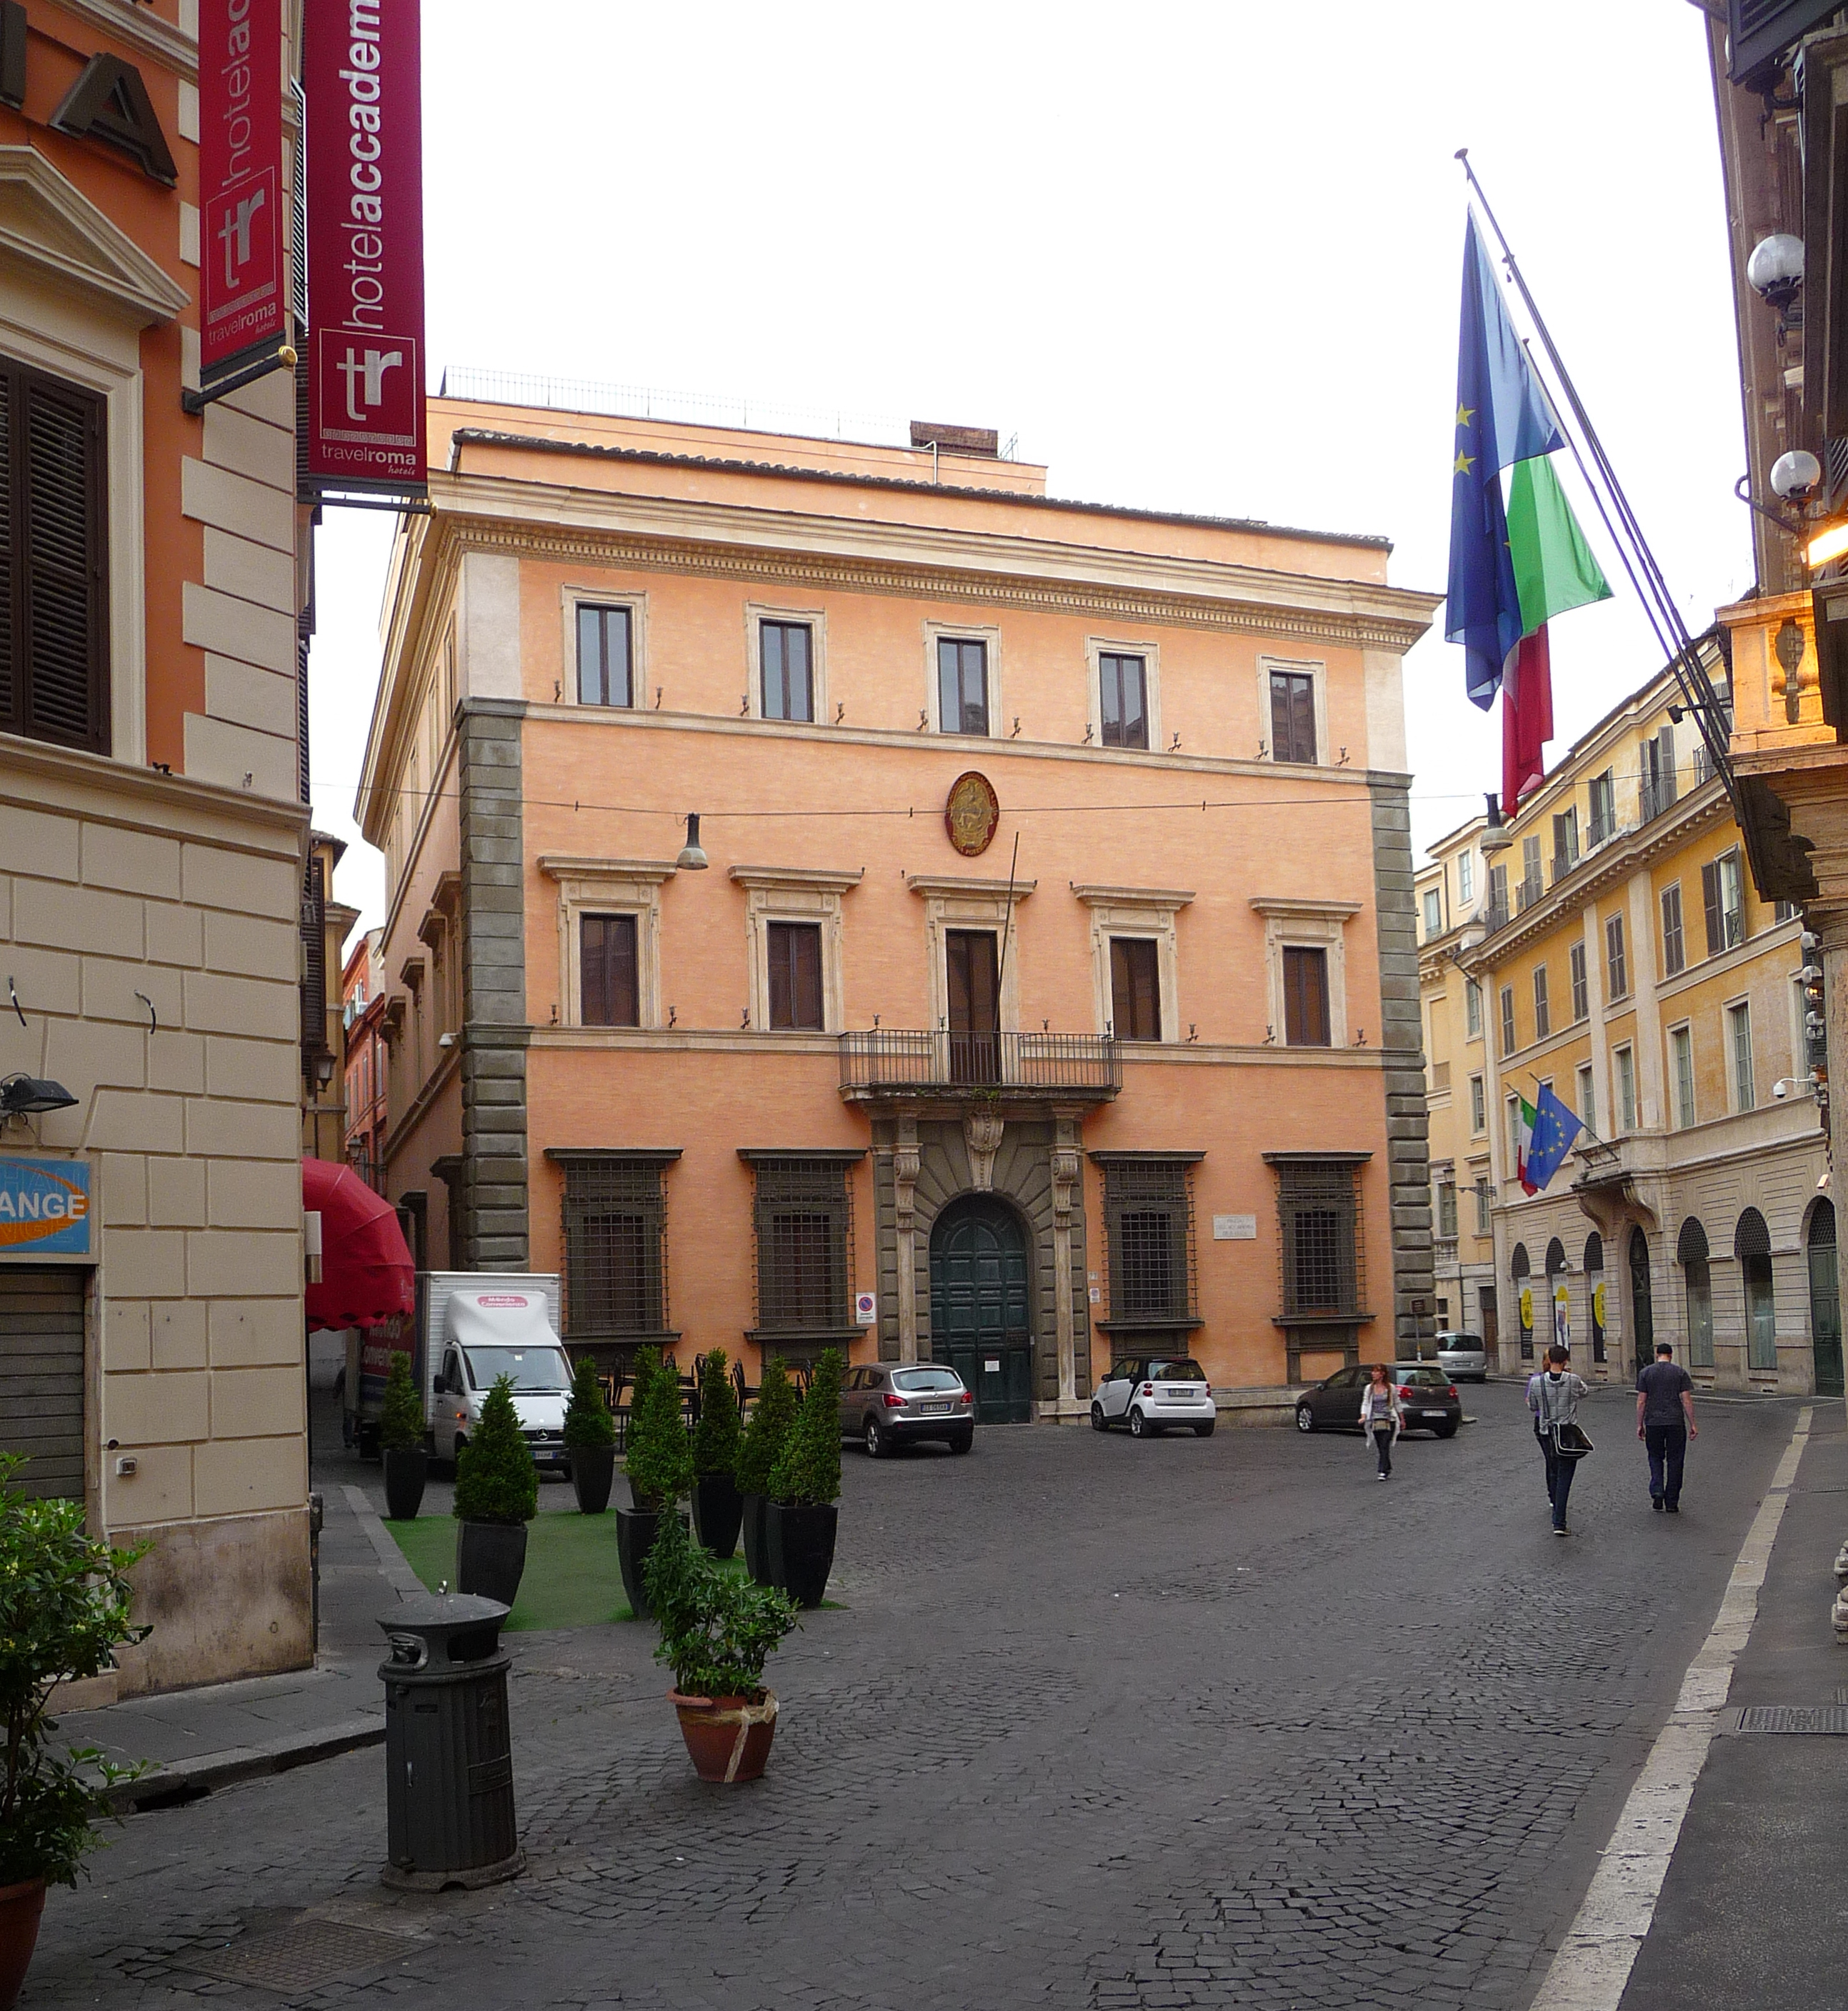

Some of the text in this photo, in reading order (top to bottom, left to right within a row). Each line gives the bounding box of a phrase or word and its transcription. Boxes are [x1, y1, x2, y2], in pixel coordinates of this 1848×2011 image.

[209, 301, 277, 346] travelroma
[321, 443, 416, 466] travelroma
[388, 464, 416, 476] hotels
